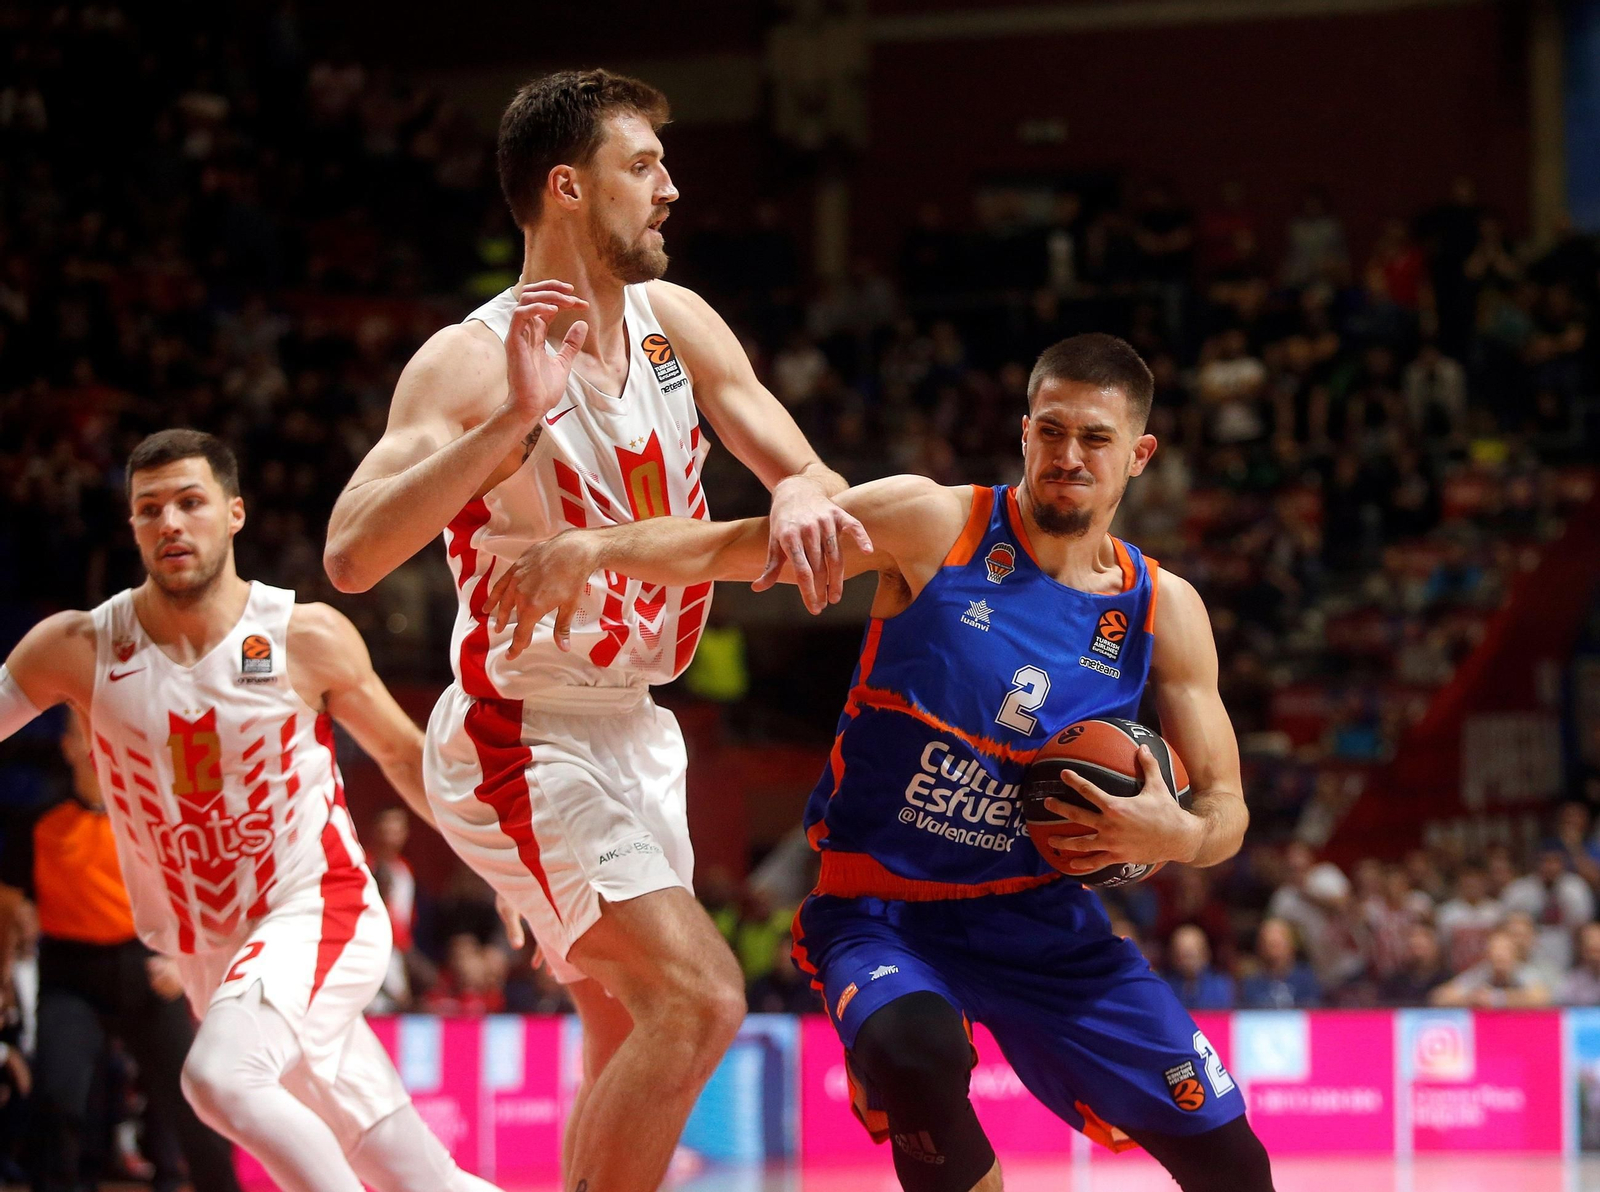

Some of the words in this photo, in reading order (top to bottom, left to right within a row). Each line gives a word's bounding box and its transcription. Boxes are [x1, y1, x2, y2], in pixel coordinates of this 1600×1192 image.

[661, 378, 688, 394] neteam
[960, 615, 990, 632] luanvi
[1093, 641, 1118, 656] AIRLINES
[1095, 636, 1120, 651] TURKISH
[1079, 656, 1121, 679] oneteam
[995, 665, 1051, 736] 2
[166, 731, 224, 795] 12
[905, 772, 1022, 828] Esfue
[153, 808, 275, 868] mts
[1192, 1030, 1235, 1098] 2
